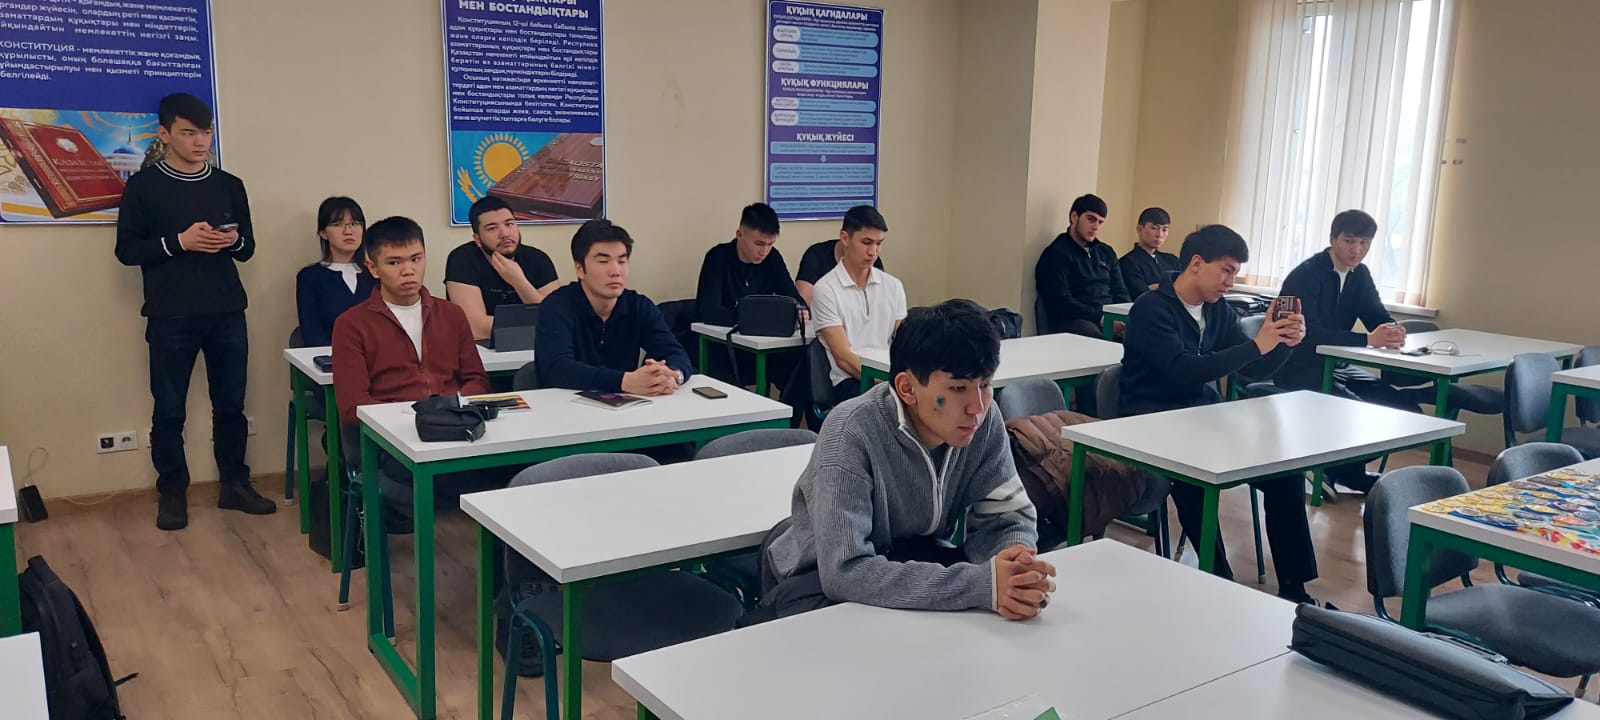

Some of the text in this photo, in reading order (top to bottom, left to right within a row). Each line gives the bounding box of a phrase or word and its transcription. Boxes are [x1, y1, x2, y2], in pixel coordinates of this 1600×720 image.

[0, 2, 38, 11] ргандар
[459, 1, 589, 18] МЕН БОСТАНДЫҚТАРЫ
[1, 21, 65, 32] йқындайтын
